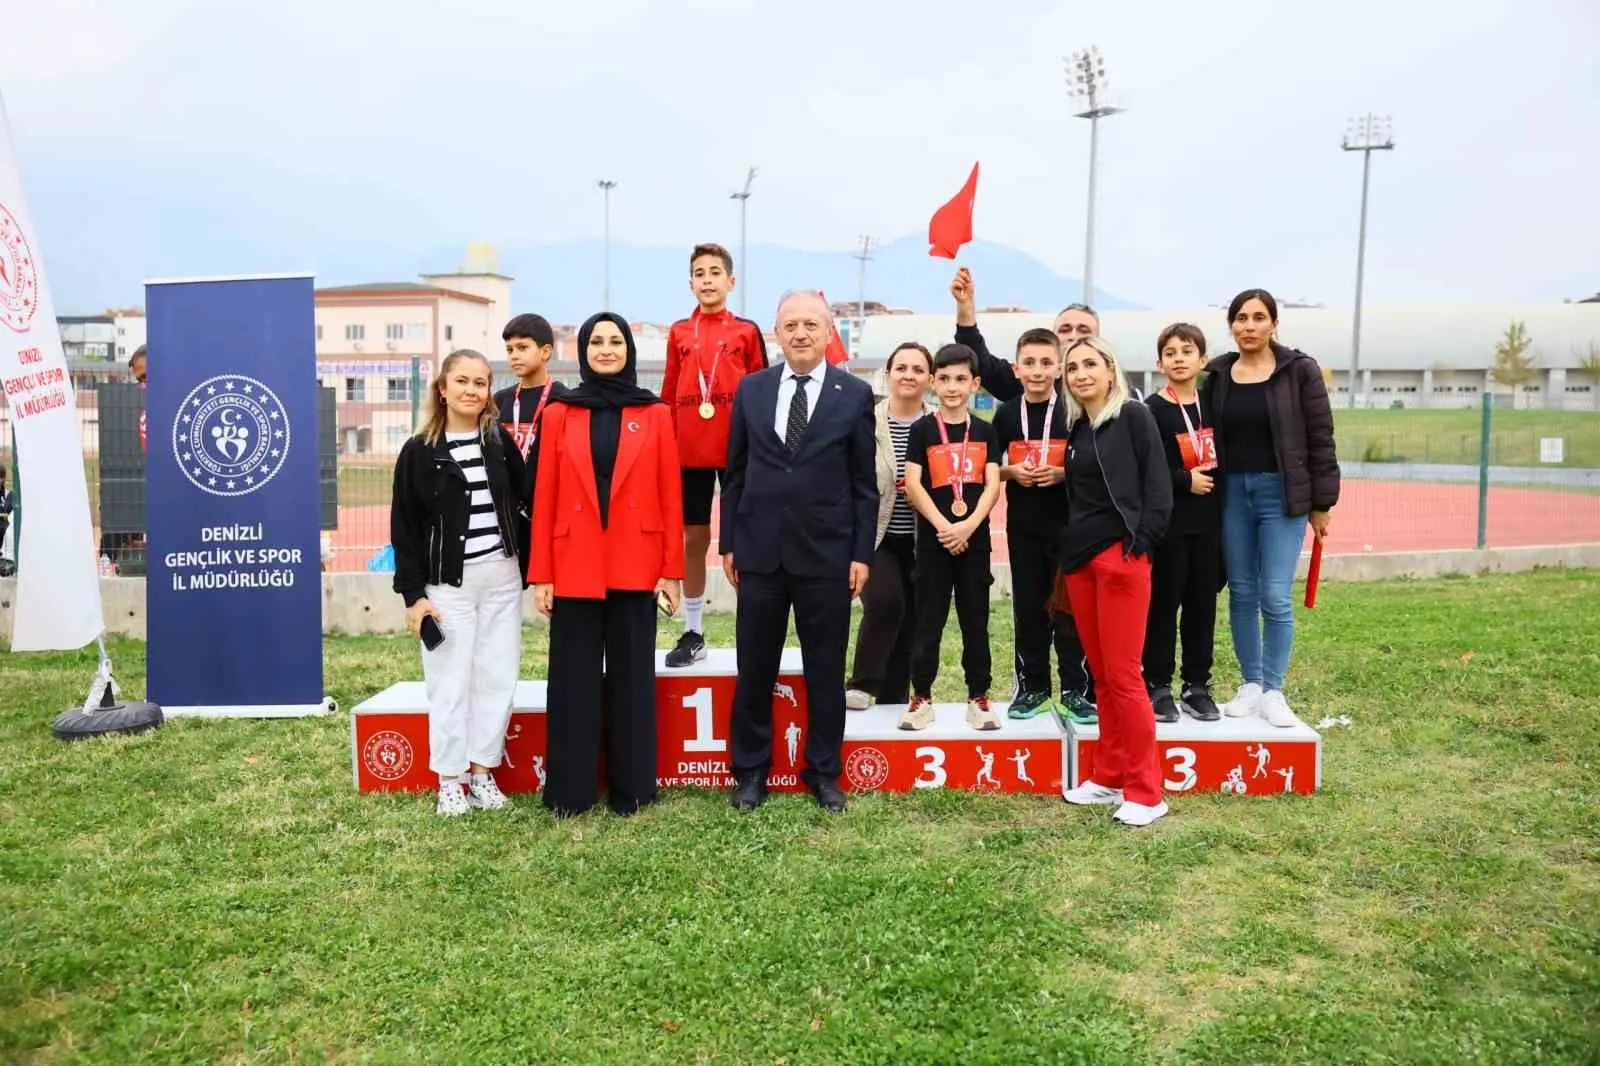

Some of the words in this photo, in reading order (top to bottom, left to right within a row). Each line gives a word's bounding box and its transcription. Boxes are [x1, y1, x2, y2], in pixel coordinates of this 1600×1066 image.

[251, 402, 261, 415] VE
[201, 523, 263, 542] DENİZLİ
[165, 547, 232, 569] GENÇLİK
[234, 550, 256, 564] VE
[258, 548, 302, 564] SPOR
[173, 573, 187, 591] İL
[190, 569, 295, 589] MÜDÜRLÜĞÜ
[682, 687, 727, 752] 1
[677, 759, 731, 774] DENİZL
[914, 746, 948, 789] 3
[1164, 747, 1198, 791] 3
[680, 777, 711, 787] SPOR
[712, 775, 723, 786] İL
